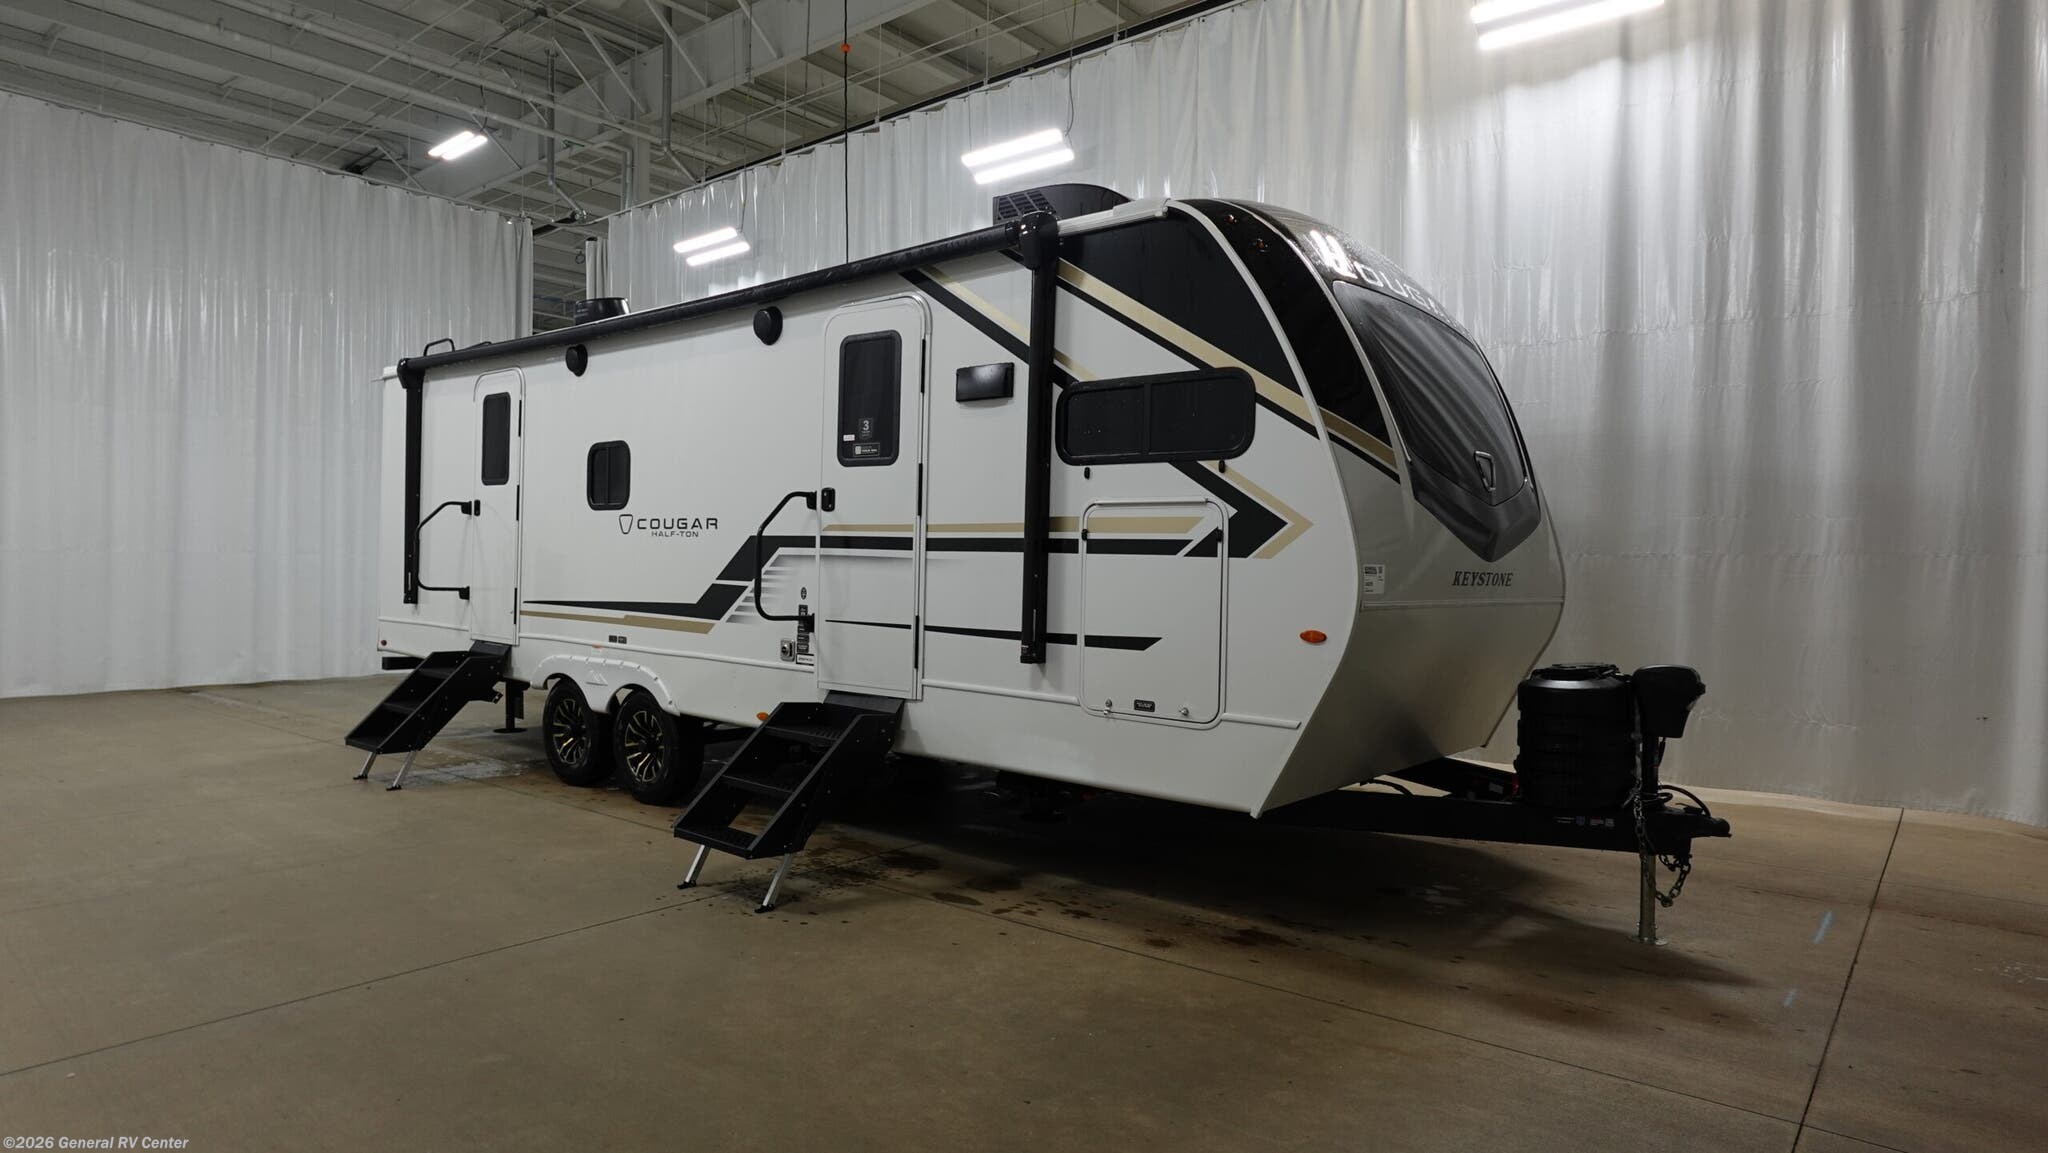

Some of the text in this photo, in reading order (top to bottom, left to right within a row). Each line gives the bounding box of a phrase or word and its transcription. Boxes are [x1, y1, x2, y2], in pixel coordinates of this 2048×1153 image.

[863, 420, 870, 431] 3
[637, 517, 718, 530] COUGAR
[651, 530, 699, 538] HALF-TON
[1451, 570, 1514, 587] KEYSTONE
